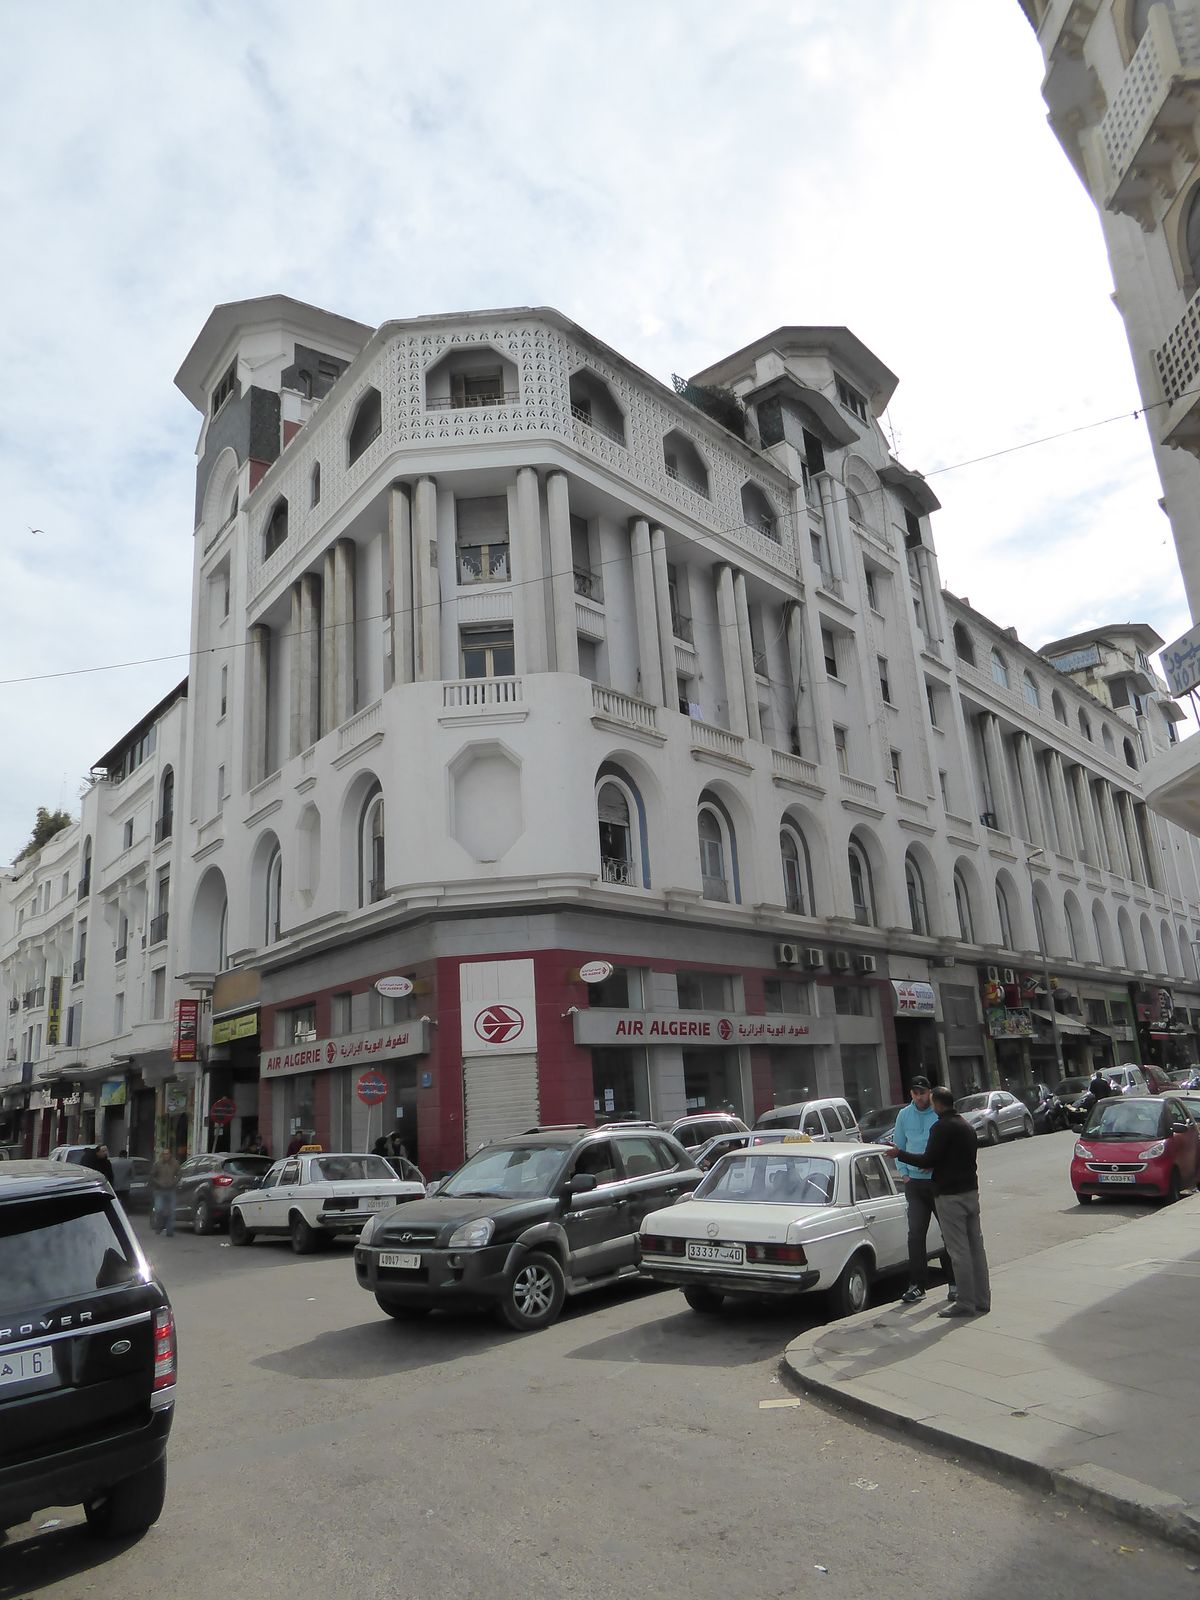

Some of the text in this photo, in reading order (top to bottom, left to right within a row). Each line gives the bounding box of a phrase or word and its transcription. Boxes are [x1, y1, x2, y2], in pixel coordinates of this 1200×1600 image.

[1173, 657, 1200, 691] HOT
[616, 1020, 710, 1036] AIR ALGERIE
[267, 1049, 321, 1070] AIR ALGERIE
[690, 1246, 719, 1258] 33337
[729, 1249, 741, 1260] 40
[0, 1311, 93, 1339] ROVER
[32, 1352, 42, 1374] 6
